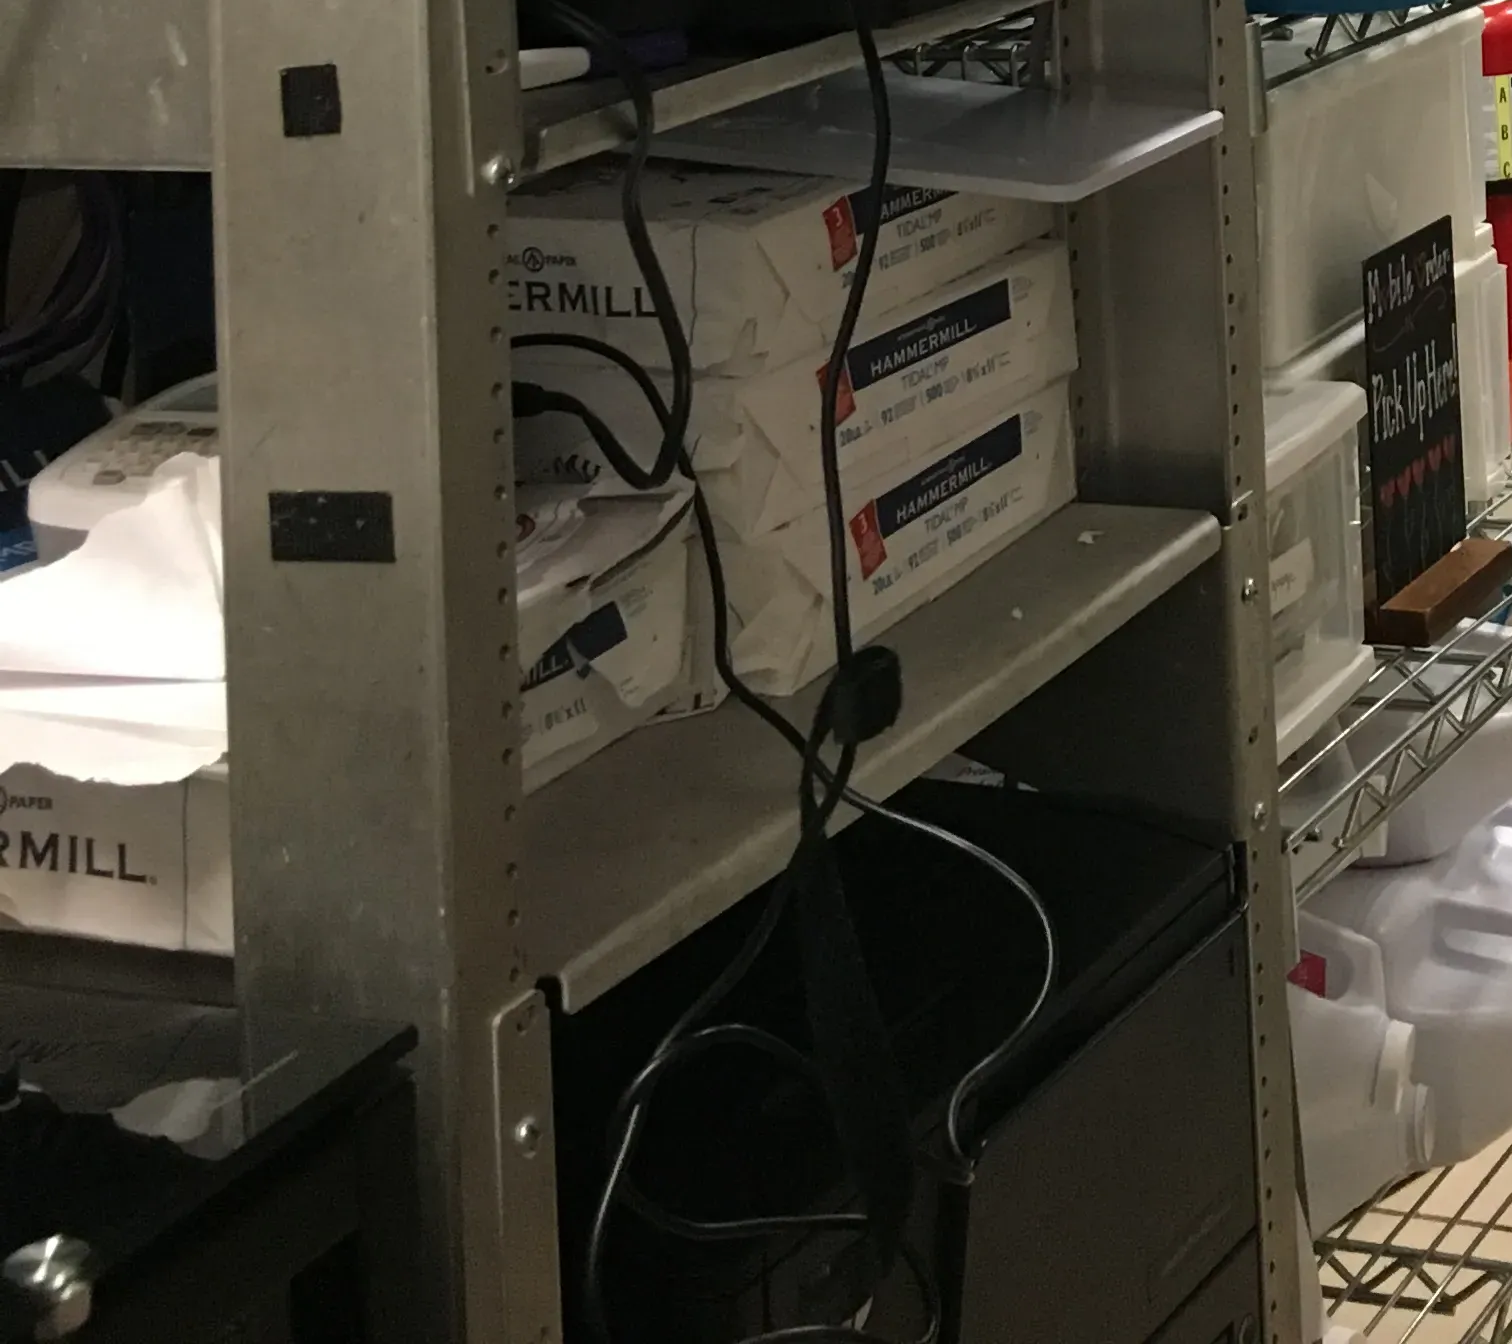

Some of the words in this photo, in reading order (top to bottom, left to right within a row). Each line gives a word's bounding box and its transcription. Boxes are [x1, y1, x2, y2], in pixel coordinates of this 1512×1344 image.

[1499, 86, 1507, 104] A
[1501, 124, 1509, 141] B
[869, 318, 974, 378] HAMMERMILL
[1372, 367, 1406, 443] Pick
[1406, 351, 1427, 442] Up
[896, 457, 990, 524] HAMMERMILL
